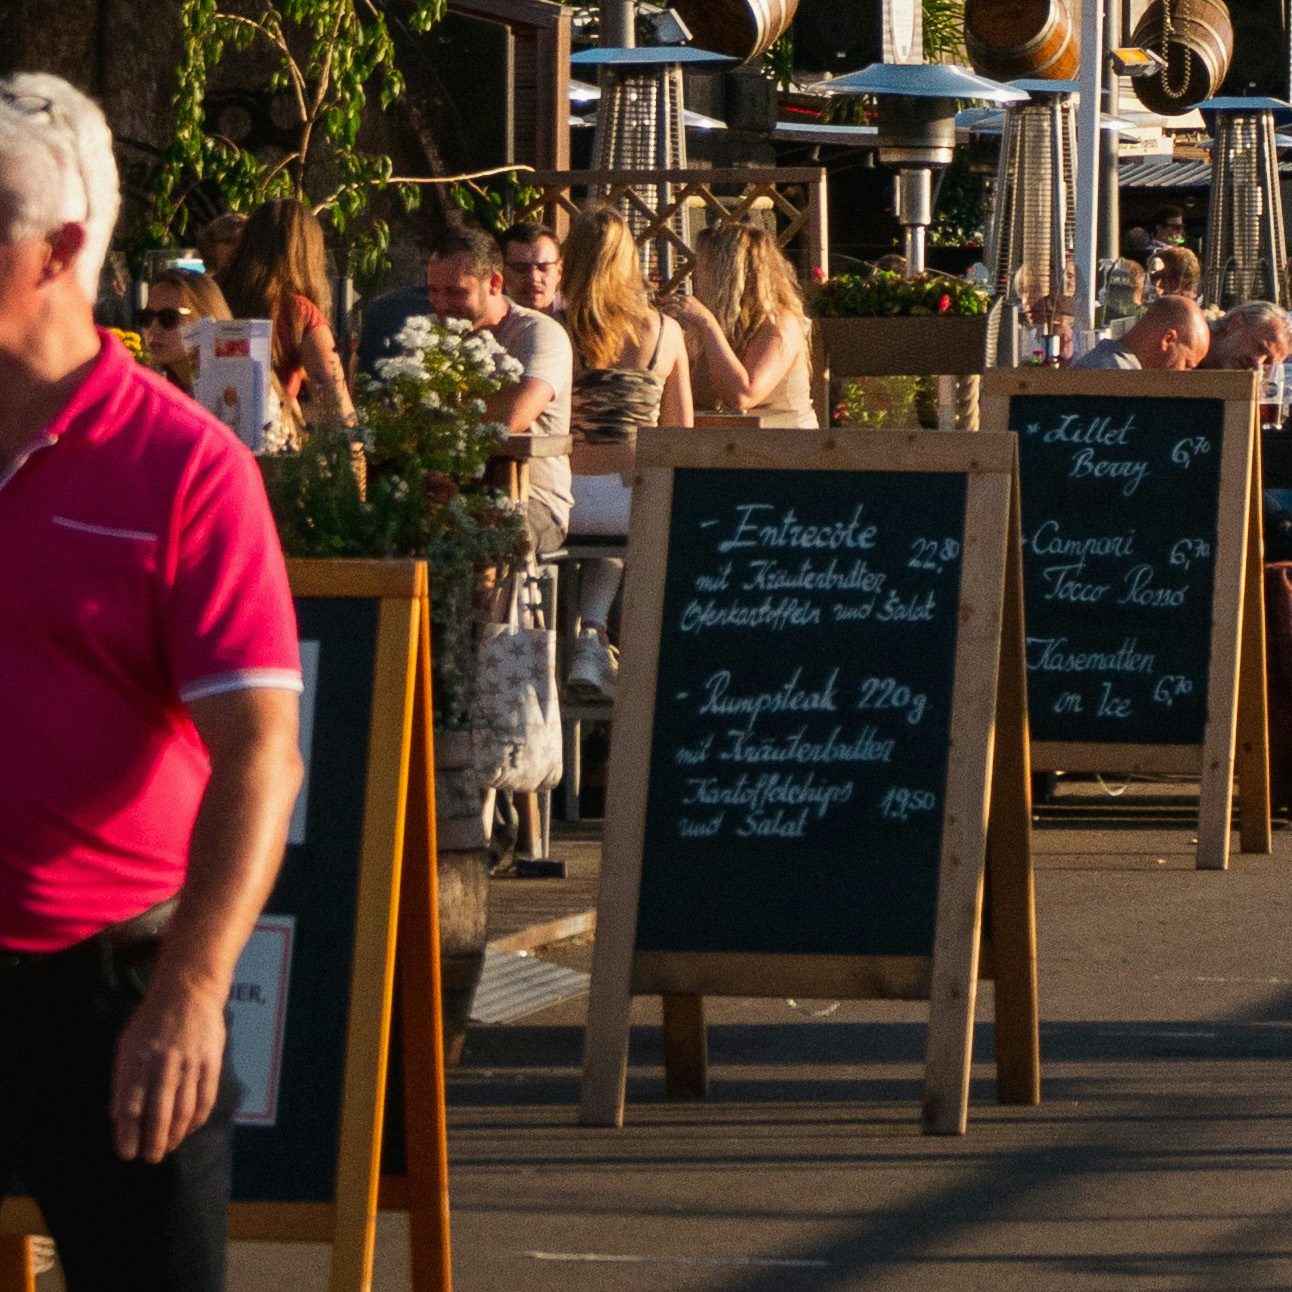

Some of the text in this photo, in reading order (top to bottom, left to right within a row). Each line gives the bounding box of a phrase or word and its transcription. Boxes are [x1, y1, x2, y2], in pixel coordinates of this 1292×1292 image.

[1043, 413, 1136, 446] Lillet
[1068, 446, 1151, 496] Berry
[1032, 520, 1135, 559] Campari
[694, 563, 731, 592] mit
[833, 598, 876, 622] und
[698, 665, 840, 732] Rumpsteak
[1053, 688, 1084, 714] on
[1096, 680, 1133, 718] Ice
[675, 734, 712, 765] mit
[736, 807, 810, 838] Salat
